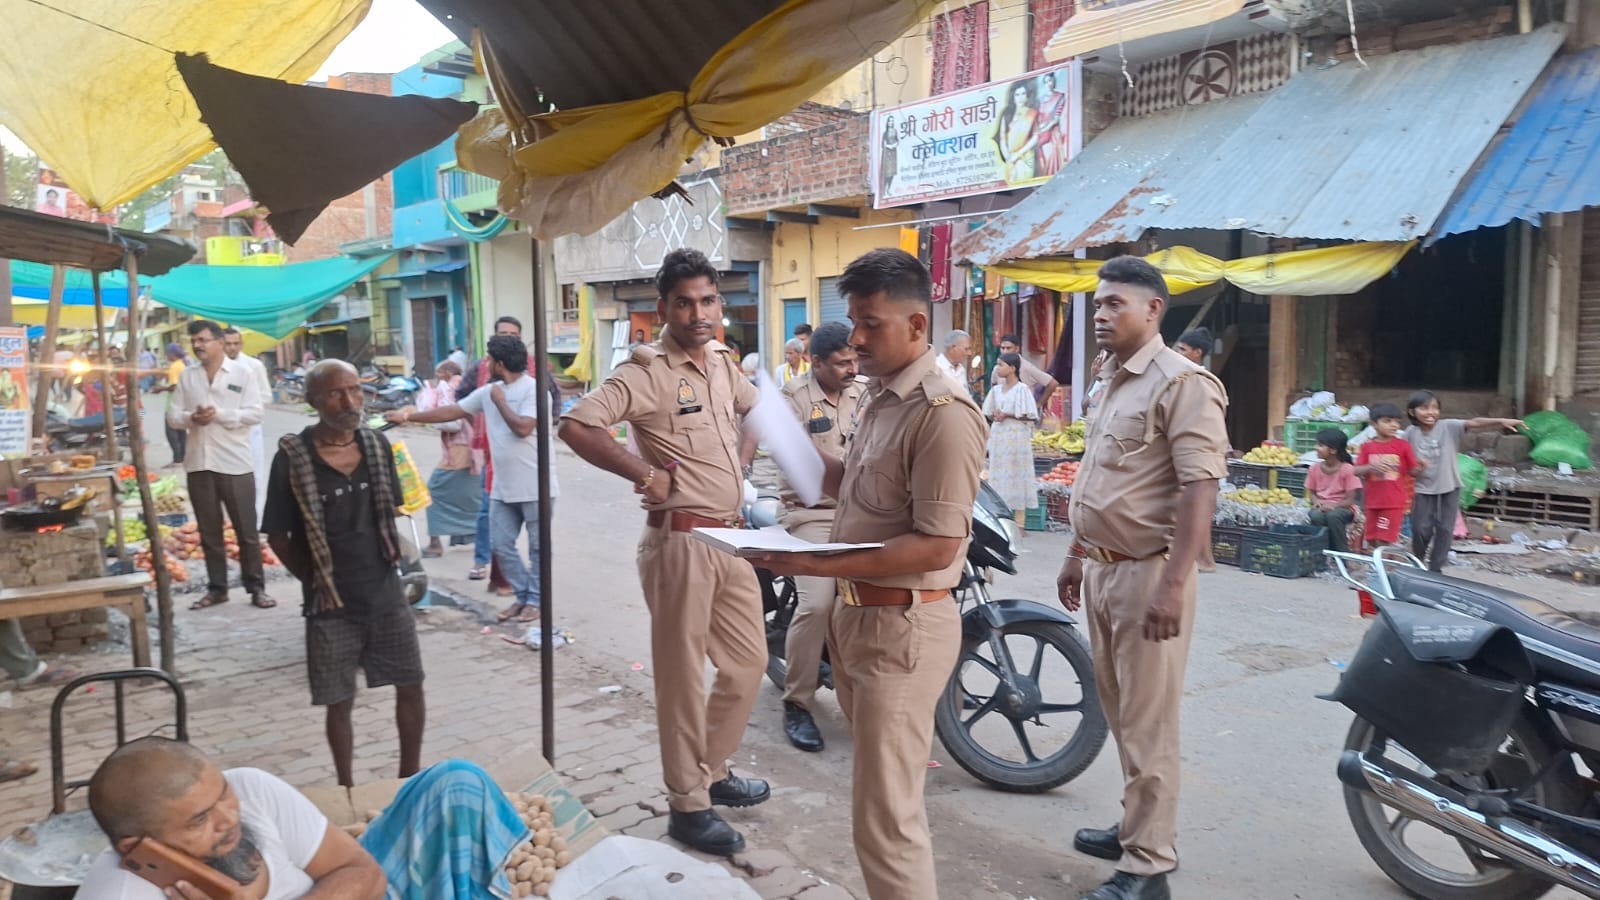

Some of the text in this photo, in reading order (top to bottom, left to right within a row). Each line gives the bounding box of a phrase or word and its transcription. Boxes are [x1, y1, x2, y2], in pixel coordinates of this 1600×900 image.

[900, 96, 997, 139] श्री गौरी साड़ी
